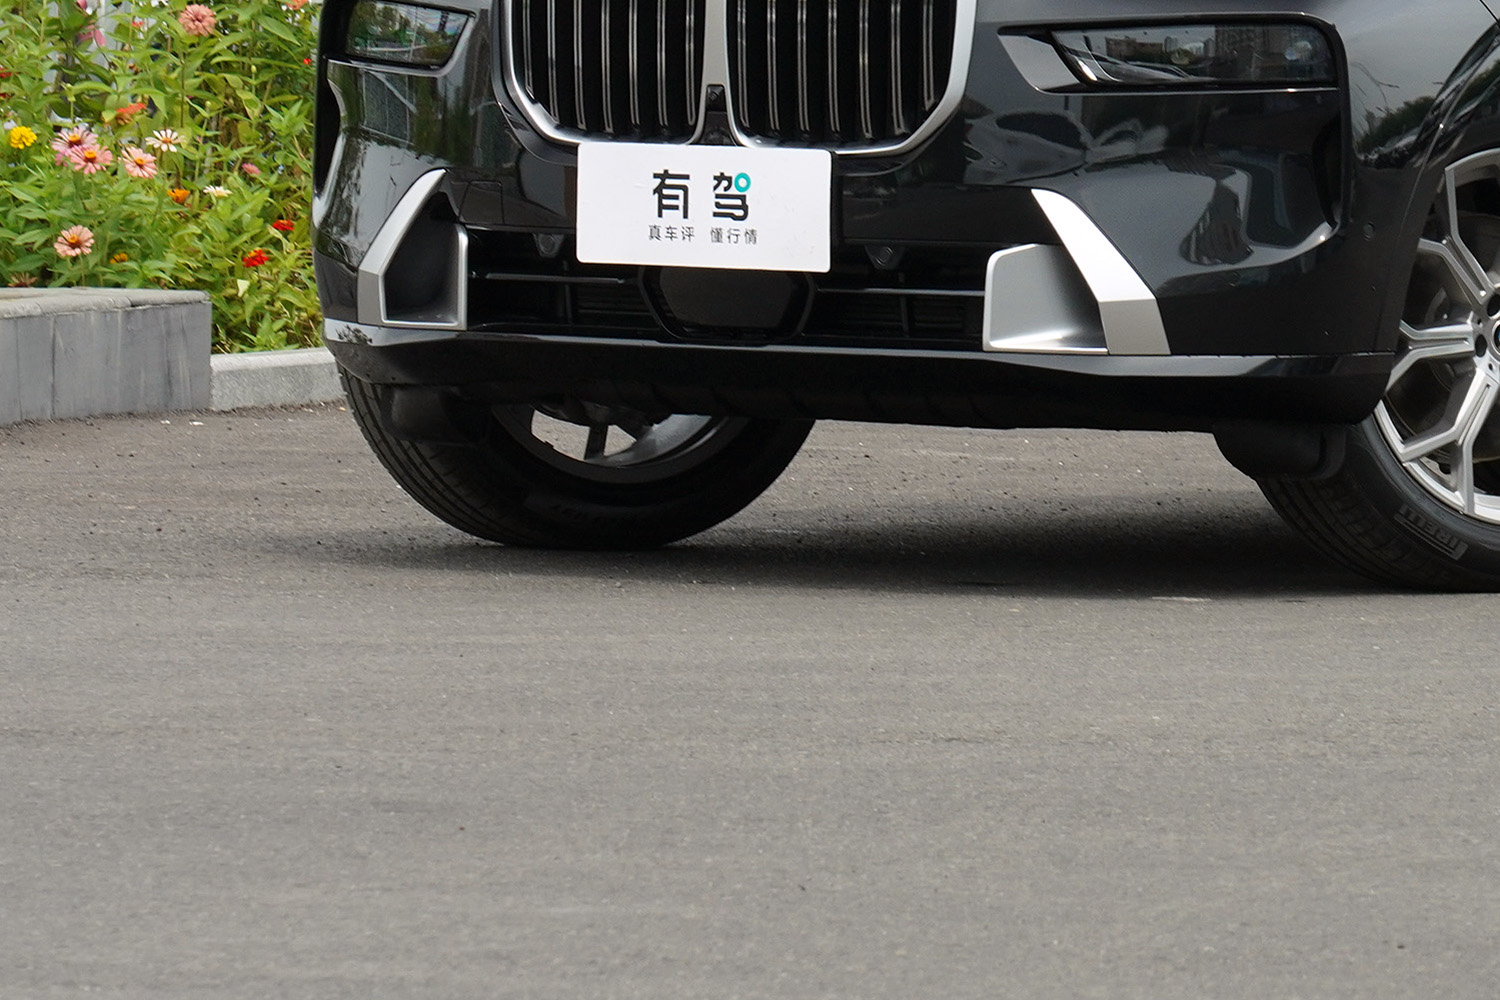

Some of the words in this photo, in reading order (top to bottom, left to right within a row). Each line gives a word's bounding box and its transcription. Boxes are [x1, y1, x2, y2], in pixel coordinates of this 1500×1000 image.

[653, 169, 751, 221] 有驾
[648, 225, 695, 241] 真车评
[710, 227, 758, 244] 懂行情
